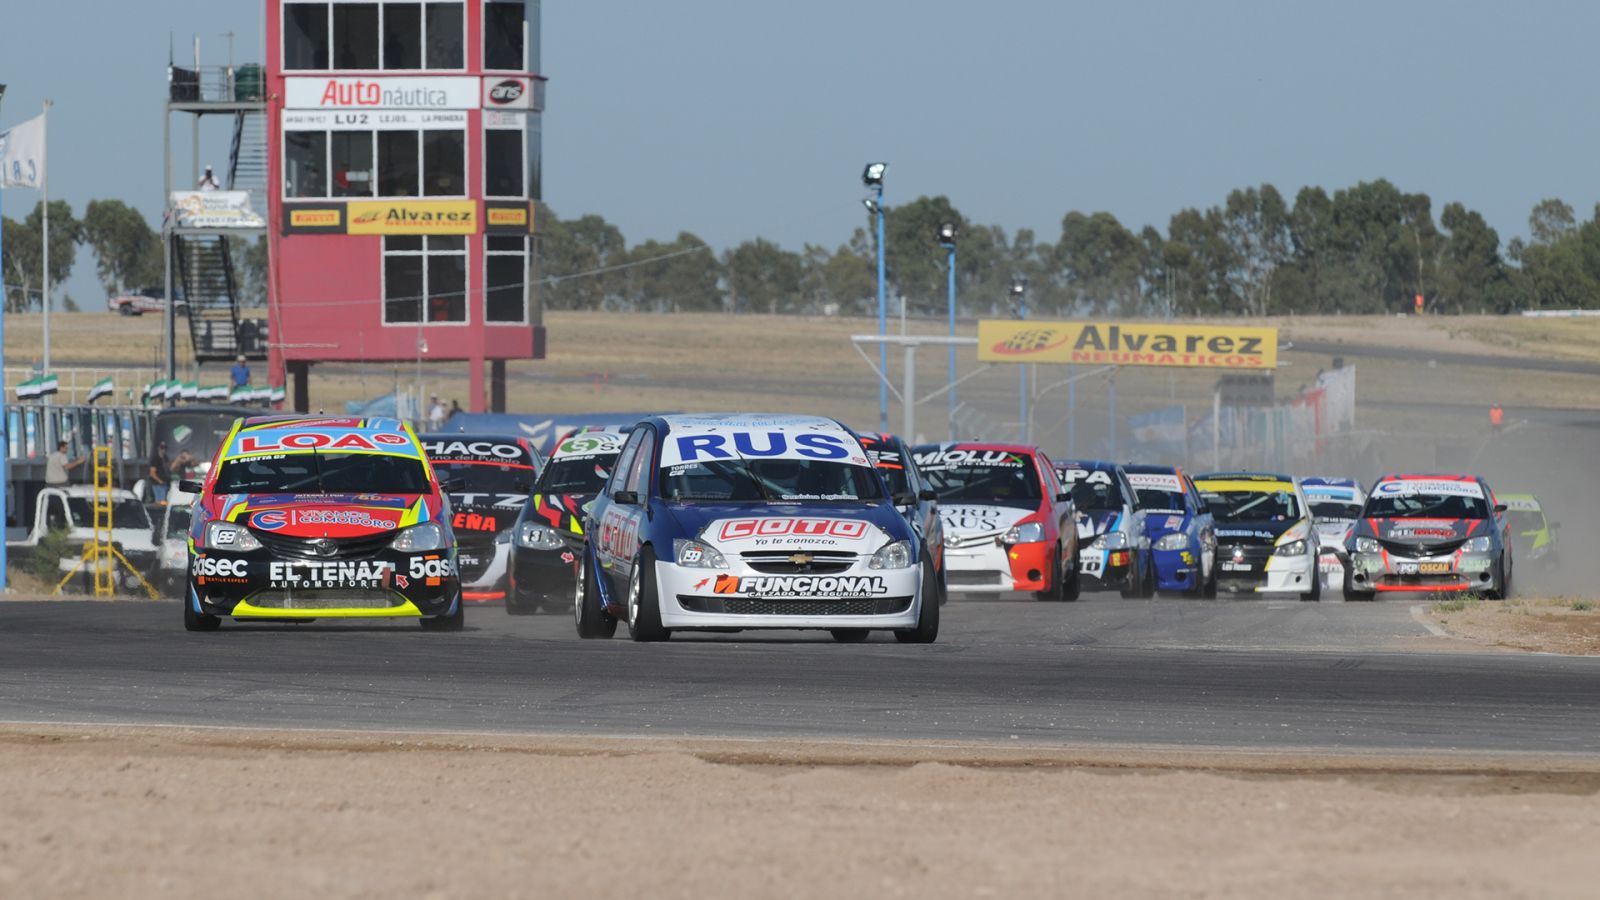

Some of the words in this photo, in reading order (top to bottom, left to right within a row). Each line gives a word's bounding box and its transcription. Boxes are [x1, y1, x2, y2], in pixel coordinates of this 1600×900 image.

[320, 79, 381, 106] Auto
[383, 87, 447, 106] náutica
[386, 208, 471, 220] Alvarez
[1073, 325, 1263, 354] Alvarez
[1071, 351, 1263, 366] NEUMATICOS
[239, 432, 381, 454] LOA
[676, 432, 850, 462] RUS
[300, 516, 396, 530] COMODORO
[720, 518, 867, 540] COTO
[270, 562, 301, 580] EL
[307, 561, 388, 580] TENAZ
[738, 576, 887, 594] FUNCIONAL
